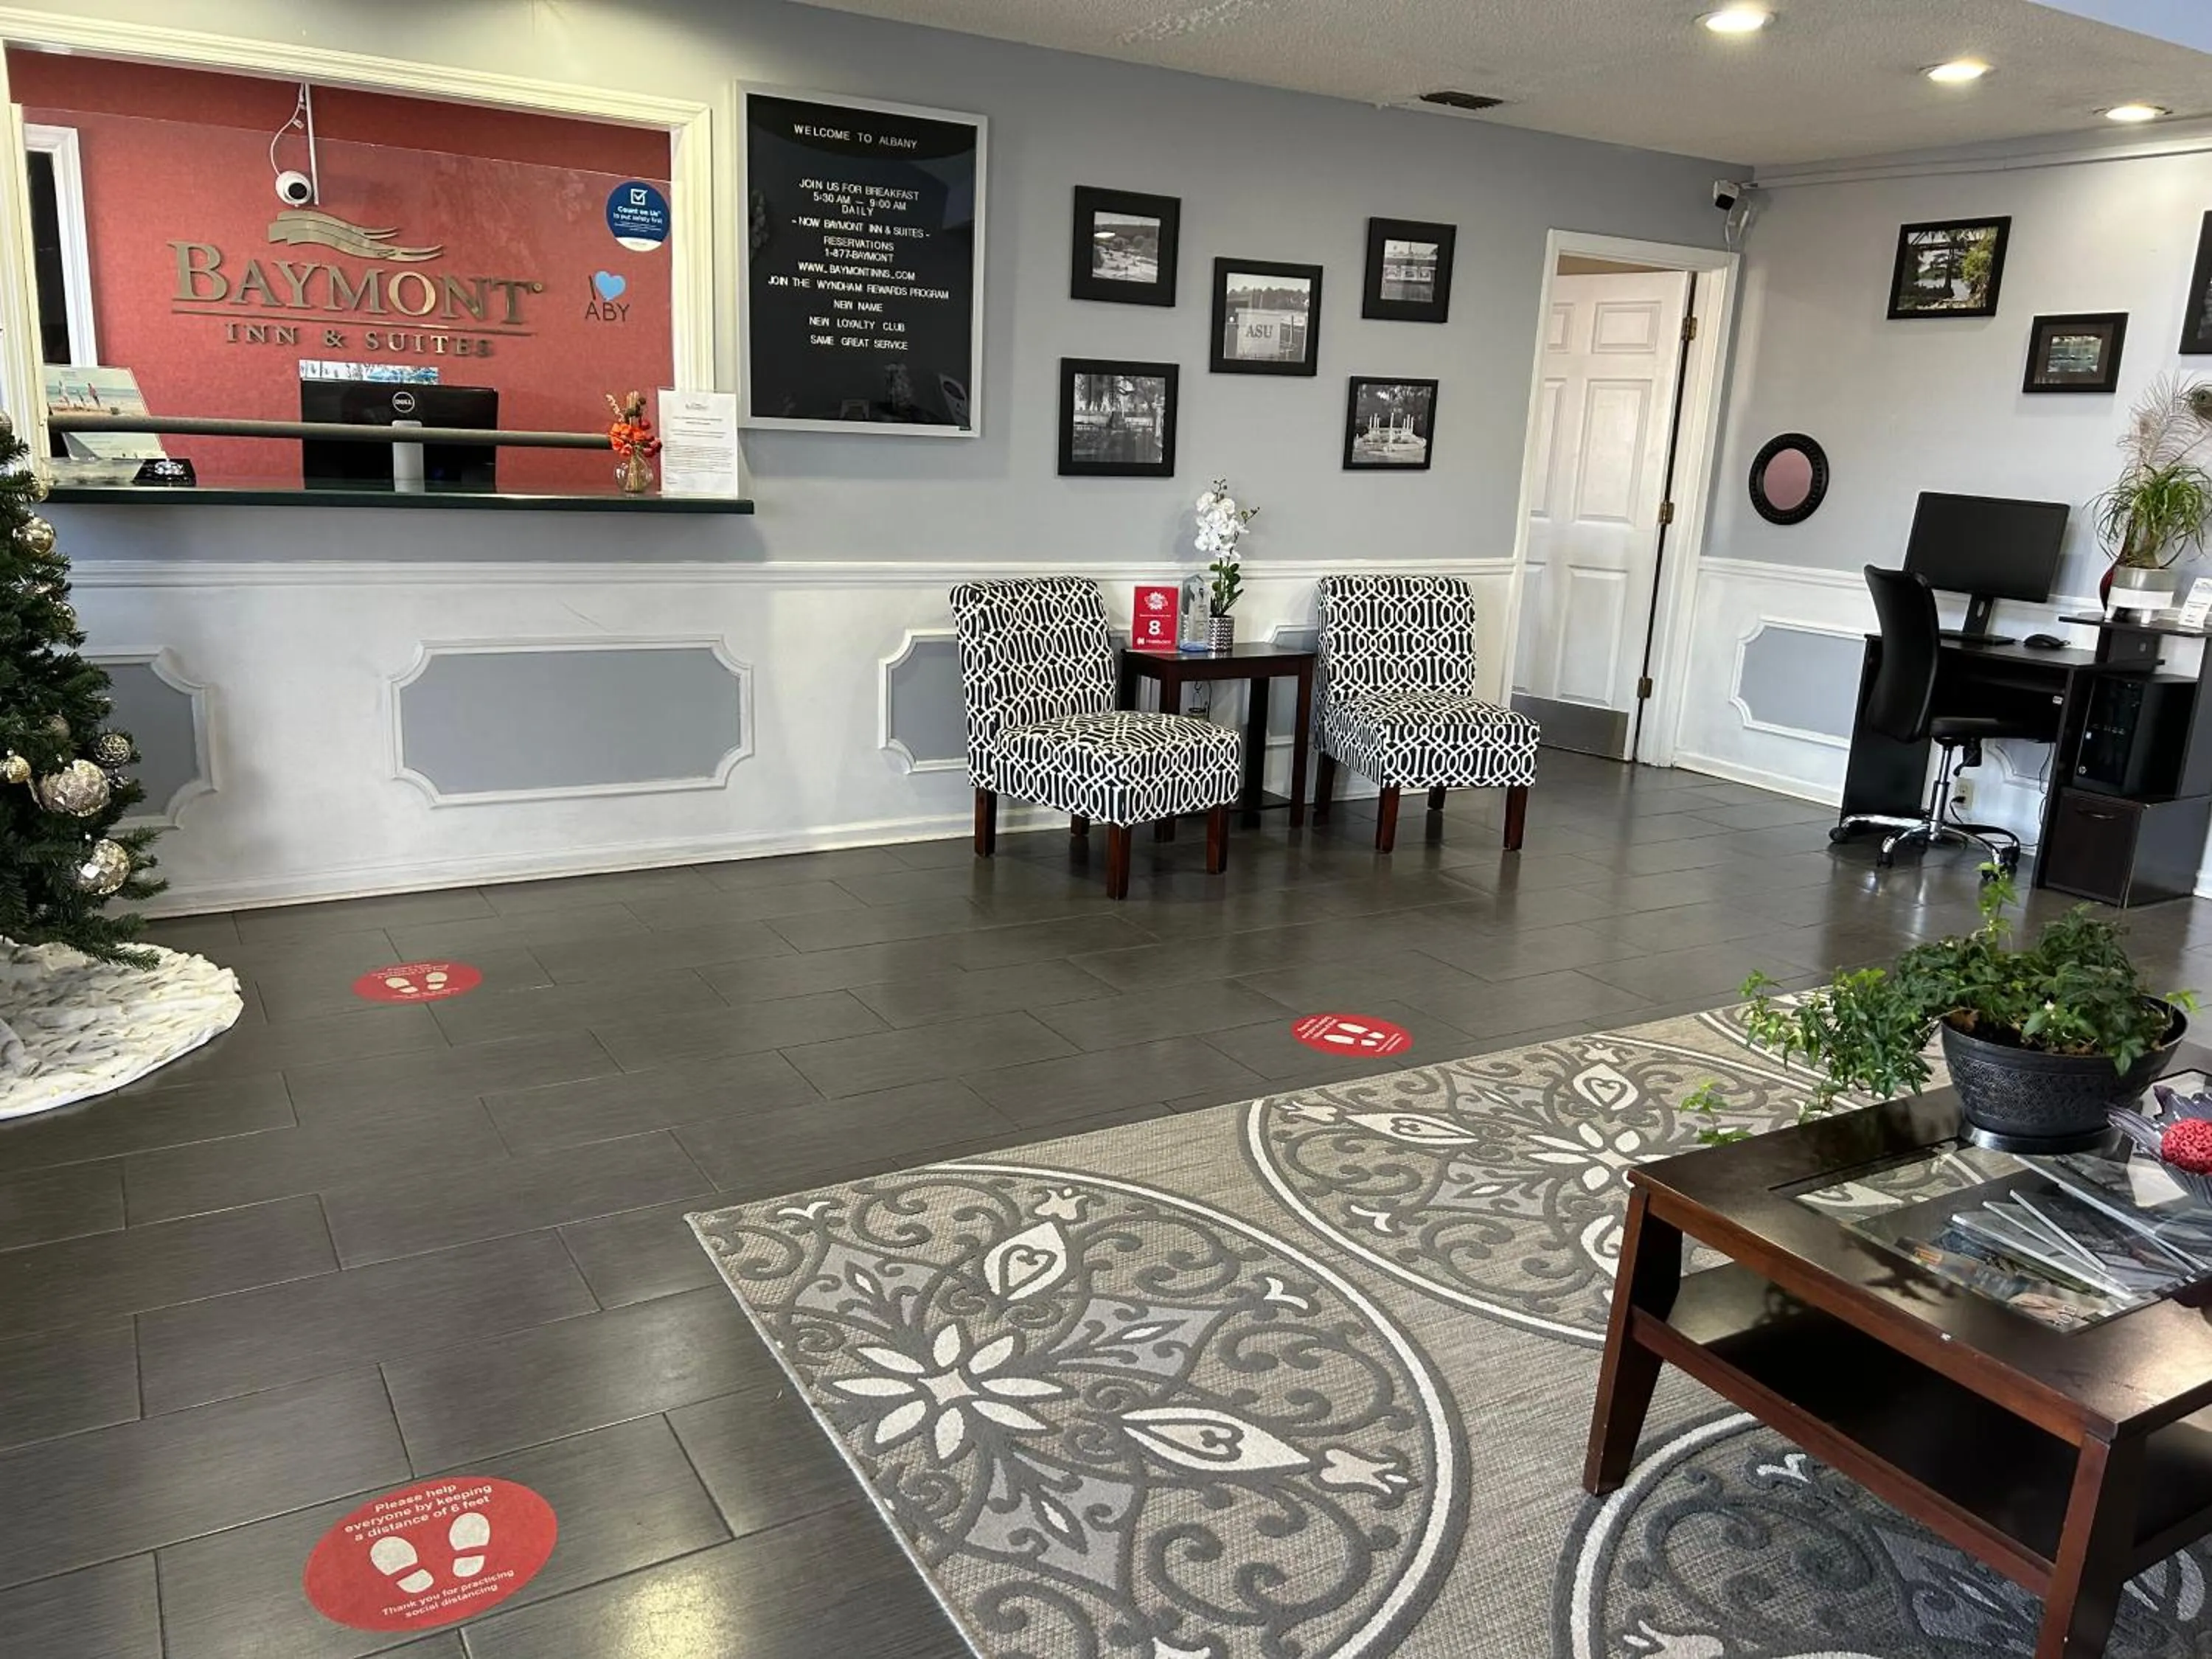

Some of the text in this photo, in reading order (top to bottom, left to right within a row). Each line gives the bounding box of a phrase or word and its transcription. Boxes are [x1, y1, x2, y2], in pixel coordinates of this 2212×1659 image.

[794, 124, 917, 149] WELCOME TO ALBANY
[799, 178, 919, 201] JOIN US FOR BREAKFAST
[813, 192, 834, 203] 5:30
[835, 195, 850, 204] AM
[869, 198, 891, 209] 9:00
[893, 201, 906, 211] AM
[841, 204, 874, 216] DAILY
[869, 223, 883, 234] INN
[885, 225, 891, 235] &
[824, 235, 894, 251] RESERVATIONS
[825, 248, 894, 262] 1-877-BAYMONT
[768, 275, 950, 299] JOIN THE WYNDHAM REWARDS PROGRAM
[585, 302, 630, 321] ABY
[833, 299, 883, 312] NEW NAME
[809, 316, 905, 332] NEW LOYALTY CLUB
[1245, 324, 1273, 338] ASU
[225, 322, 494, 358] INN & SUITES
[810, 334, 909, 350] SAME GREAT SERVICE
[375, 1484, 457, 1513] Please help
[344, 1484, 493, 1534] everyone by keeping
[368, 1514, 429, 1537] distance
[433, 1508, 448, 1518] of
[451, 1503, 460, 1513] 6
[465, 1495, 491, 1508] feet
[382, 1600, 417, 1616] Thank
[420, 1593, 441, 1605] you
[442, 1587, 459, 1597] for
[406, 1584, 498, 1618] social distancing
